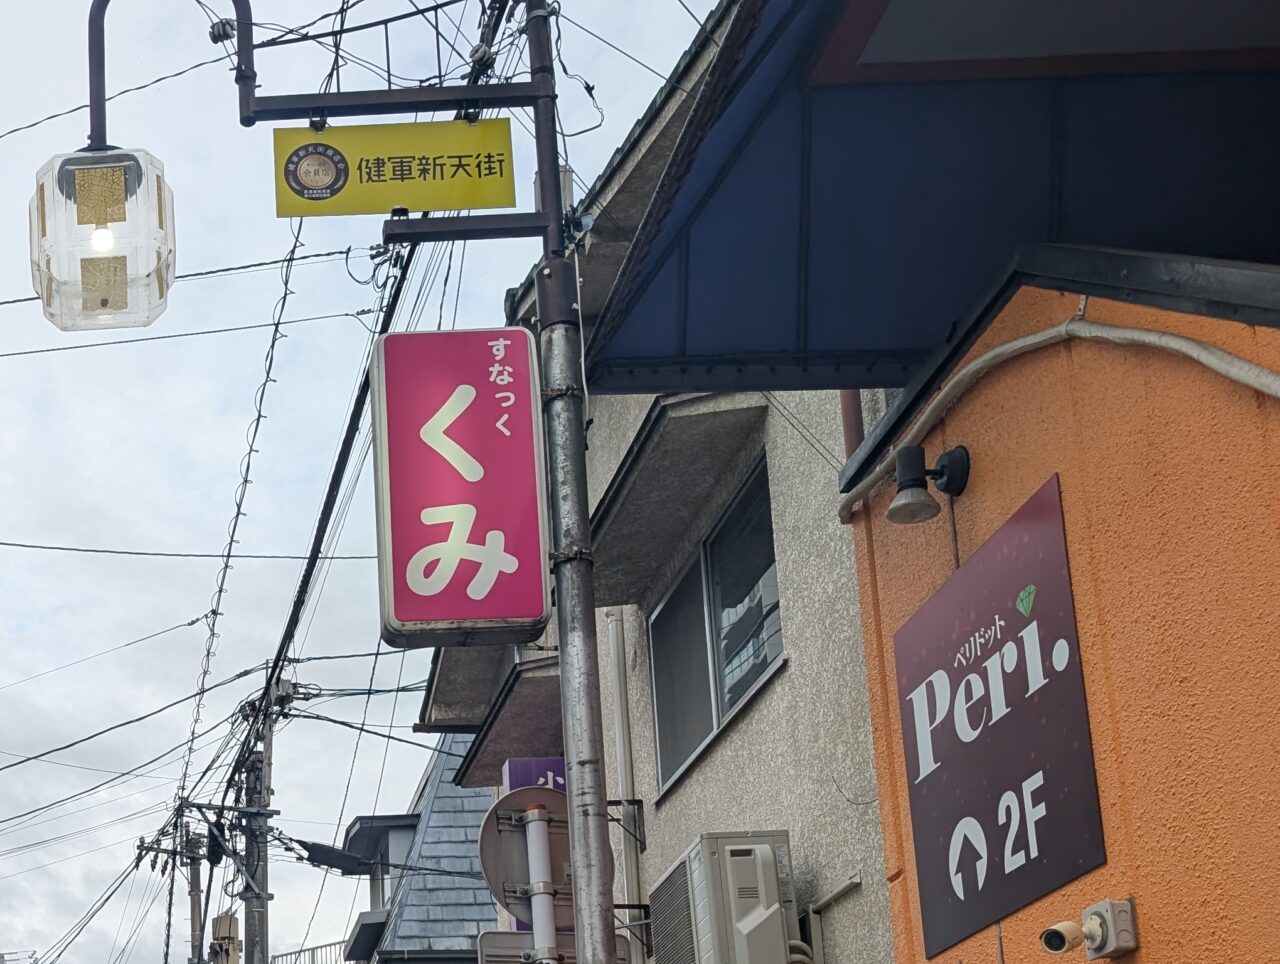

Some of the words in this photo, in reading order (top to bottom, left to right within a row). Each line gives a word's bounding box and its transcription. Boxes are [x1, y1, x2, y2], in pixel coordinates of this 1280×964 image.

[356, 152, 505, 184] 健軍新天街
[487, 337, 516, 437] すなっく
[405, 384, 519, 600] くみ
[953, 614, 1007, 670] ペリドット
[997, 770, 1048, 876] 2F
